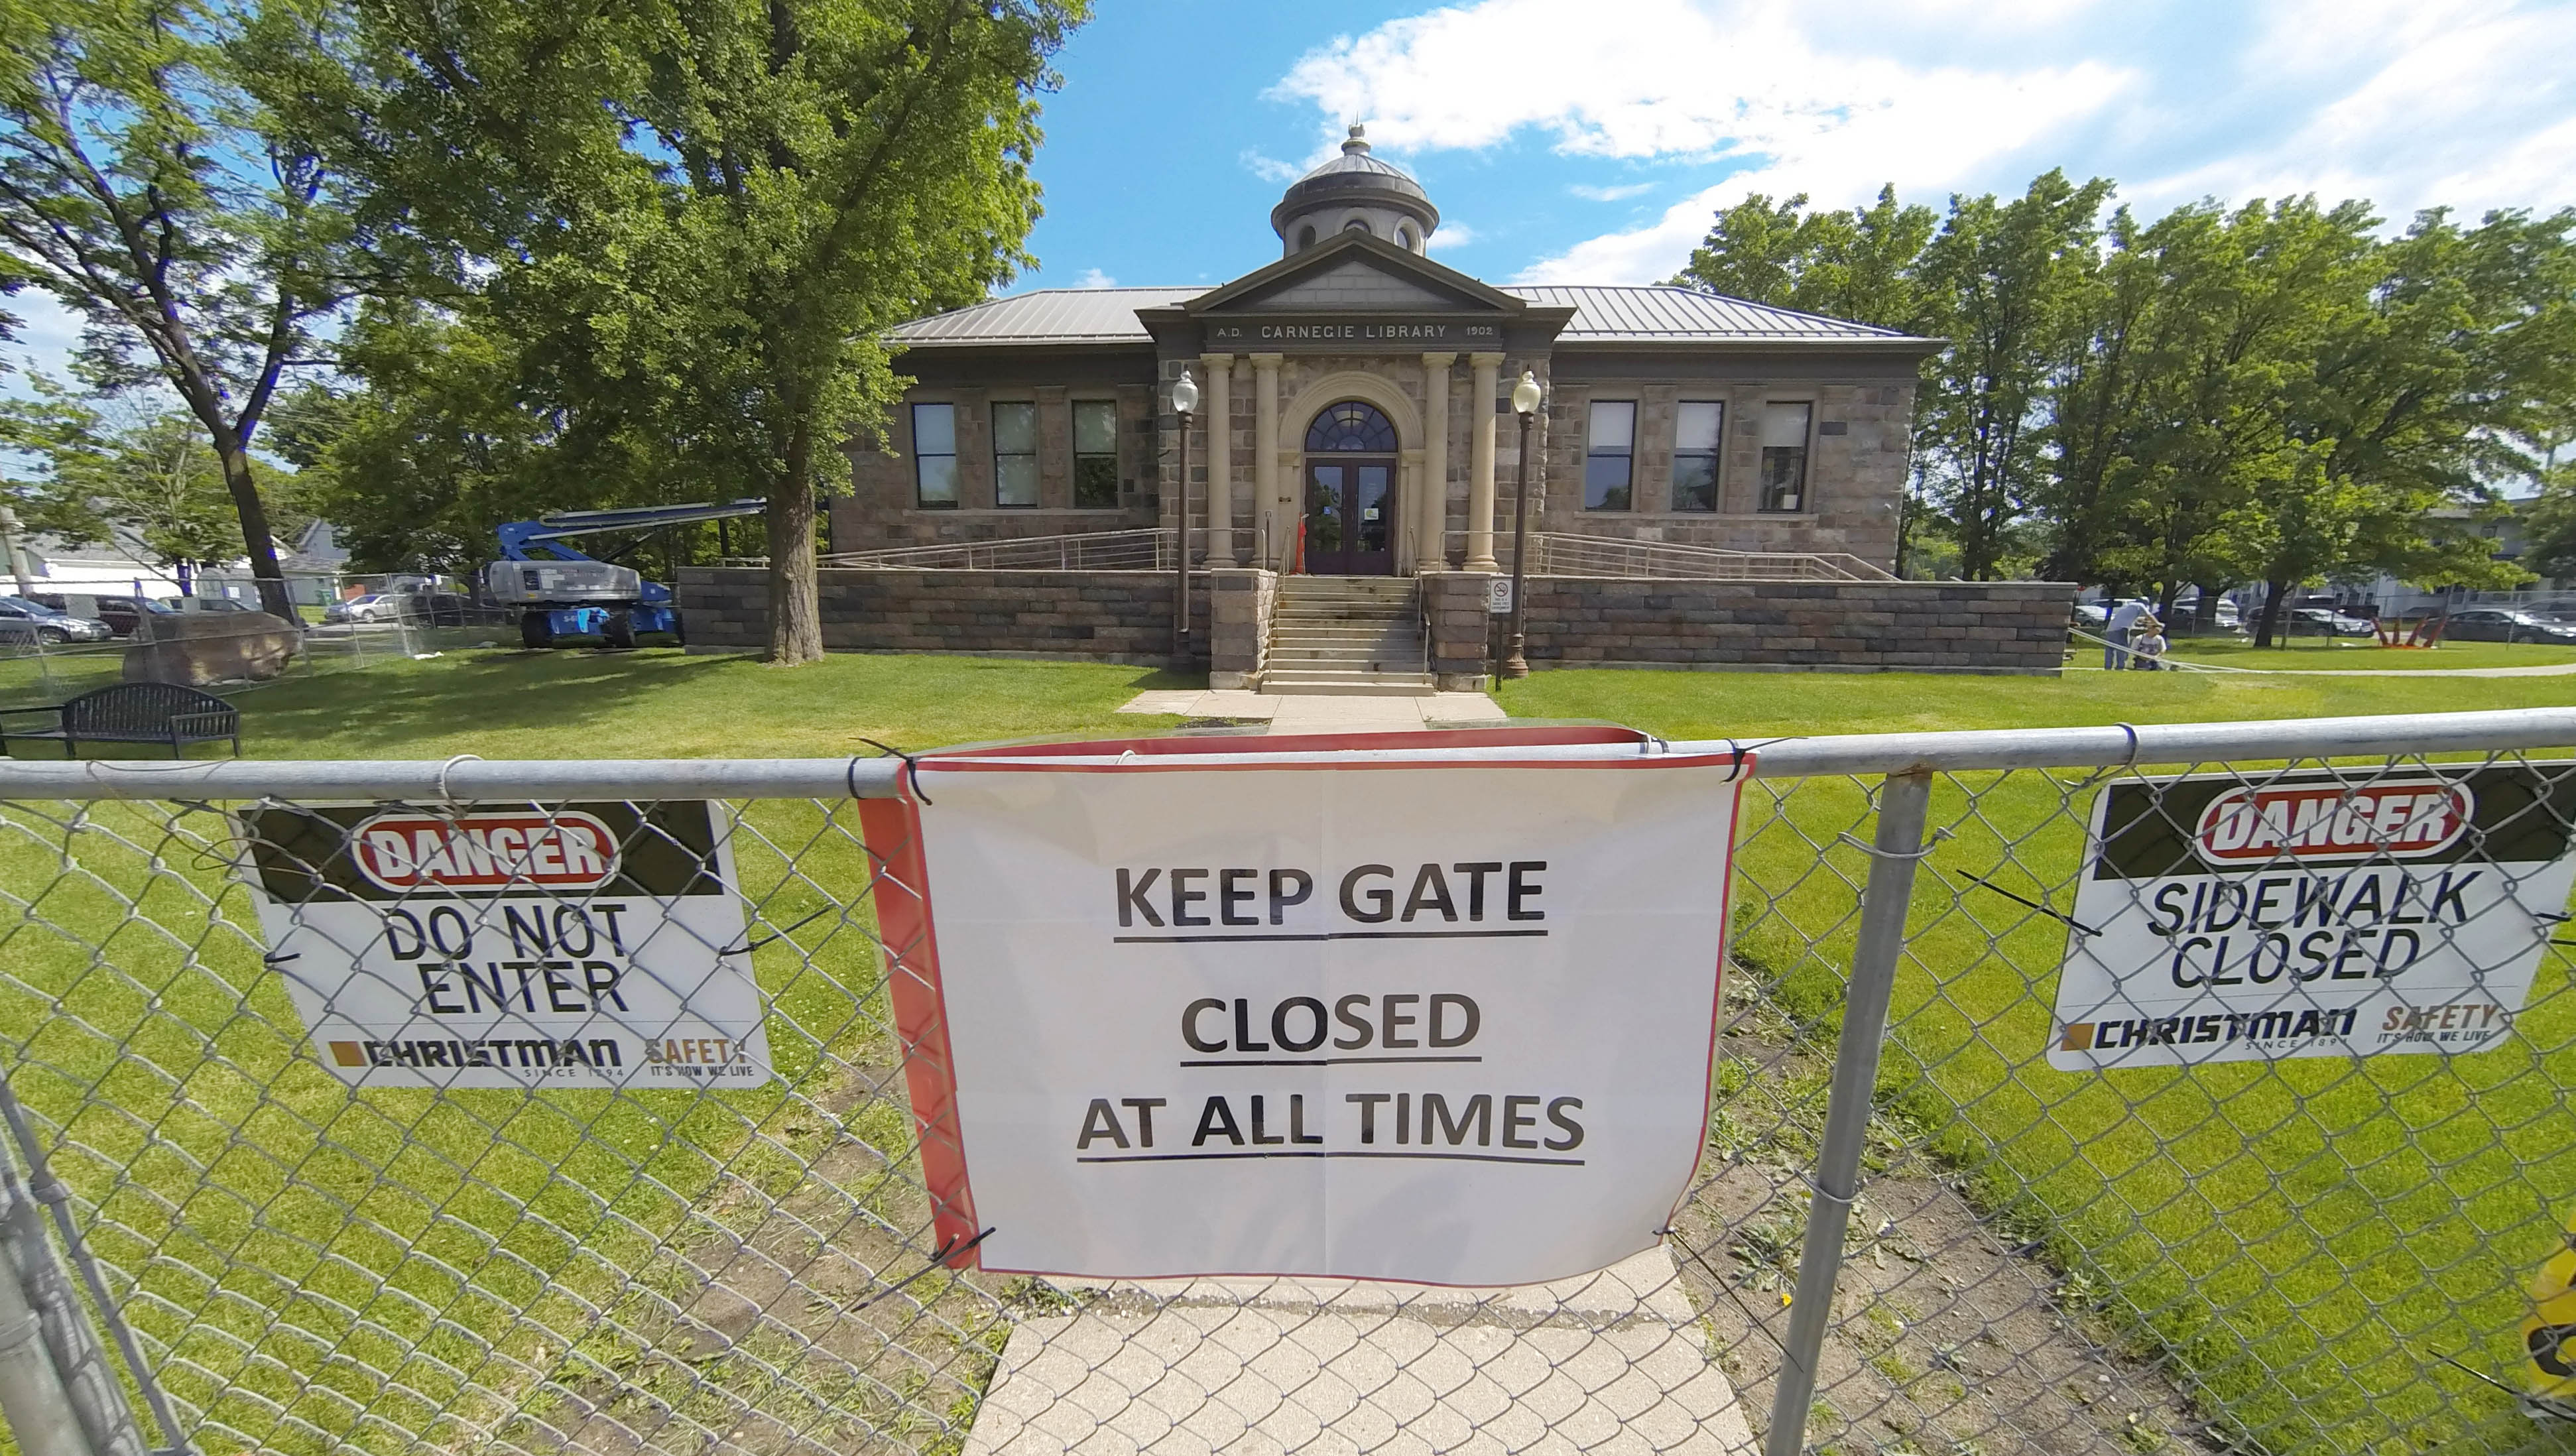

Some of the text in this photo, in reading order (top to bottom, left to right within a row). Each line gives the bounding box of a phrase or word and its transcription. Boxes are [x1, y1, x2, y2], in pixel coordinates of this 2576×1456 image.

[1217, 325, 1494, 338] A.D. CARNEGIE LIBRARY 1902
[2211, 792, 2453, 851] DANGER
[367, 825, 609, 879] DANGER
[1115, 861, 1548, 928] KEEP GATE
[2146, 871, 2483, 936] SIDEWALK
[381, 904, 629, 961] DO NOT
[2171, 928, 2420, 988] CLOSED
[420, 960, 629, 1013] ENTER
[1180, 993, 1481, 1053] CLOSED
[2094, 1008, 2358, 1049] CHRISTMAN
[2376, 1030, 2490, 1043] IT'S HOW WE LIVE
[2382, 1004, 2498, 1031] SAFETY
[363, 1039, 623, 1067] CHRISTMAN
[645, 1038, 747, 1063] SAFETY
[2244, 1040, 2298, 1050] SINCE
[524, 1069, 576, 1077] SINCE
[650, 1065, 755, 1076] IT'S HOW WE LIVE
[1076, 1092, 1585, 1152] AT ALL TIMES
